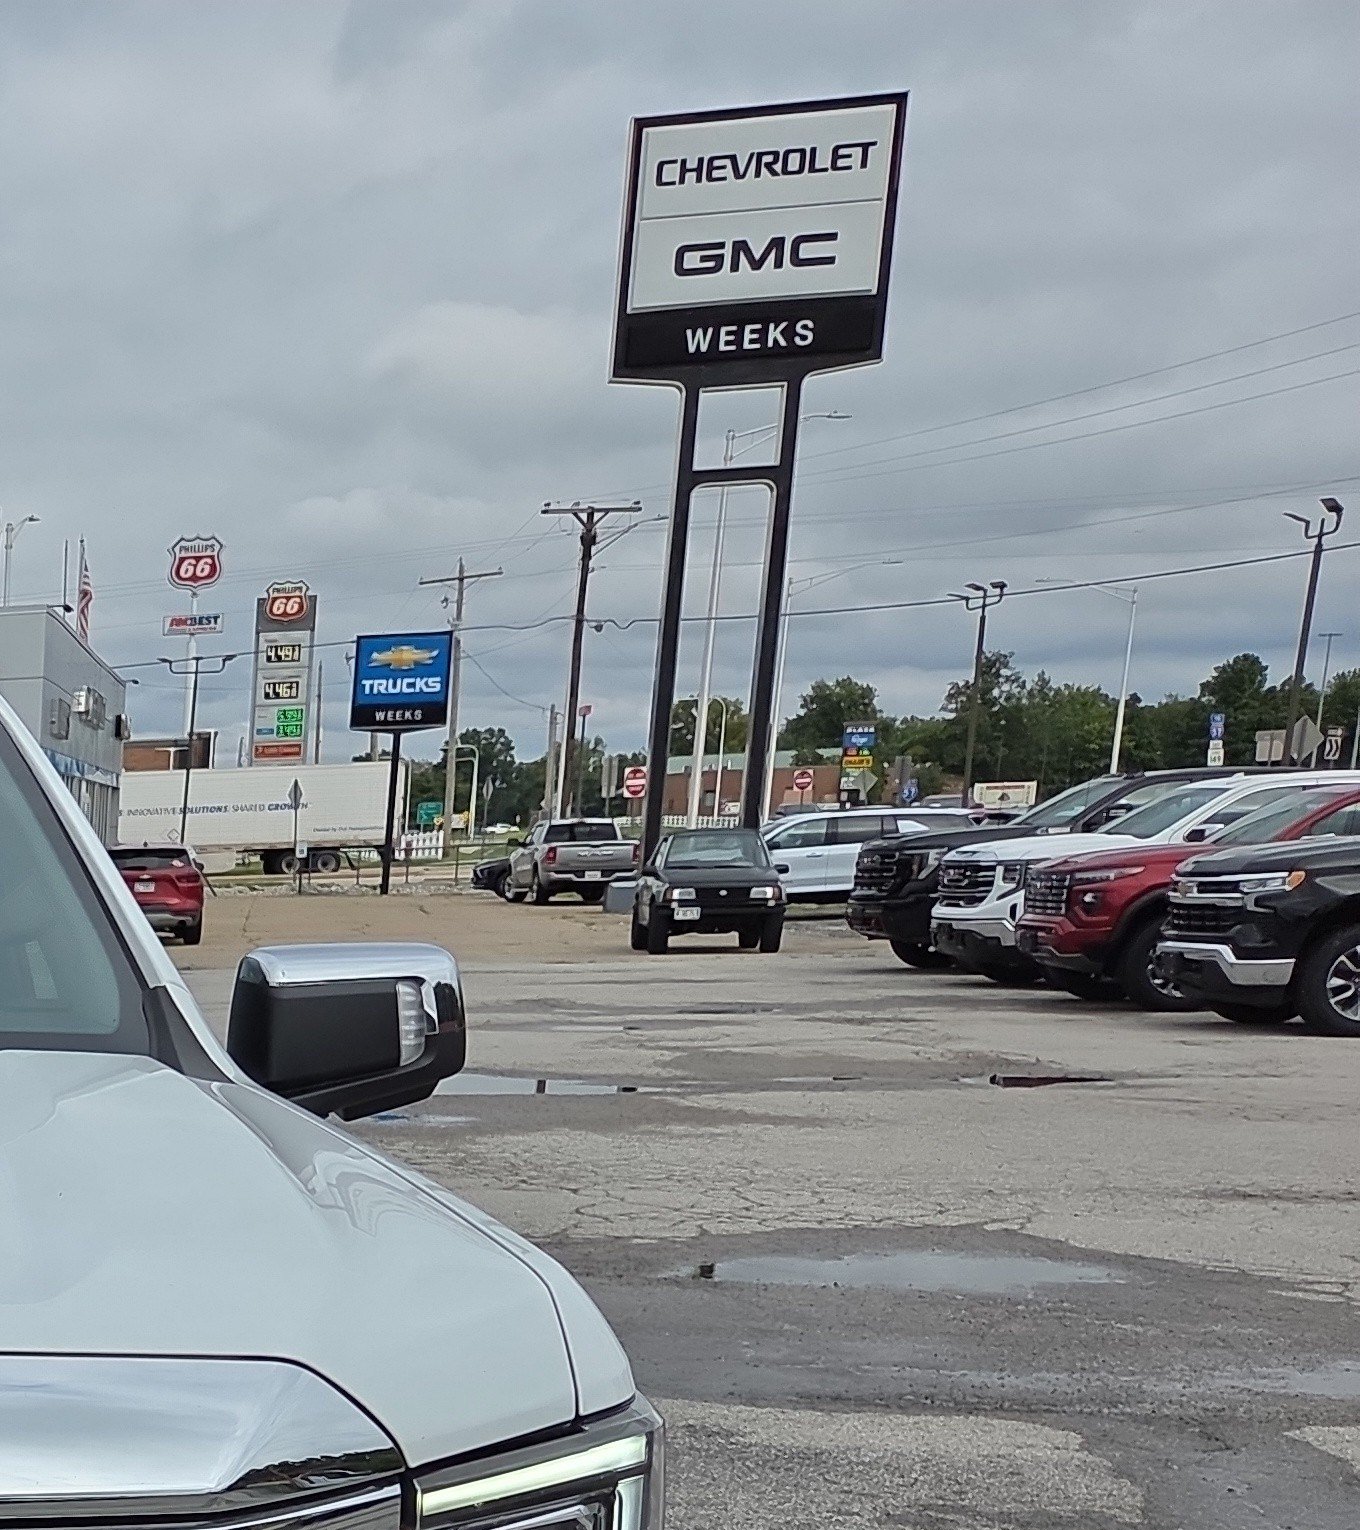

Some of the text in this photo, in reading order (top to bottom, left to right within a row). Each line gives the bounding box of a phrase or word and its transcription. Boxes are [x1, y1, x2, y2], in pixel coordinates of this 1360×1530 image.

[655, 141, 878, 187] CHEVROLET
[674, 231, 839, 277] GMC
[685, 319, 816, 354] WEEKS
[179, 543, 216, 554] PHILLIPS
[180, 558, 213, 579] 66
[272, 585, 304, 594] PHILLIPS
[272, 597, 301, 615] 66
[361, 676, 442, 695] TRUCKS
[375, 709, 423, 722] WEEKS
